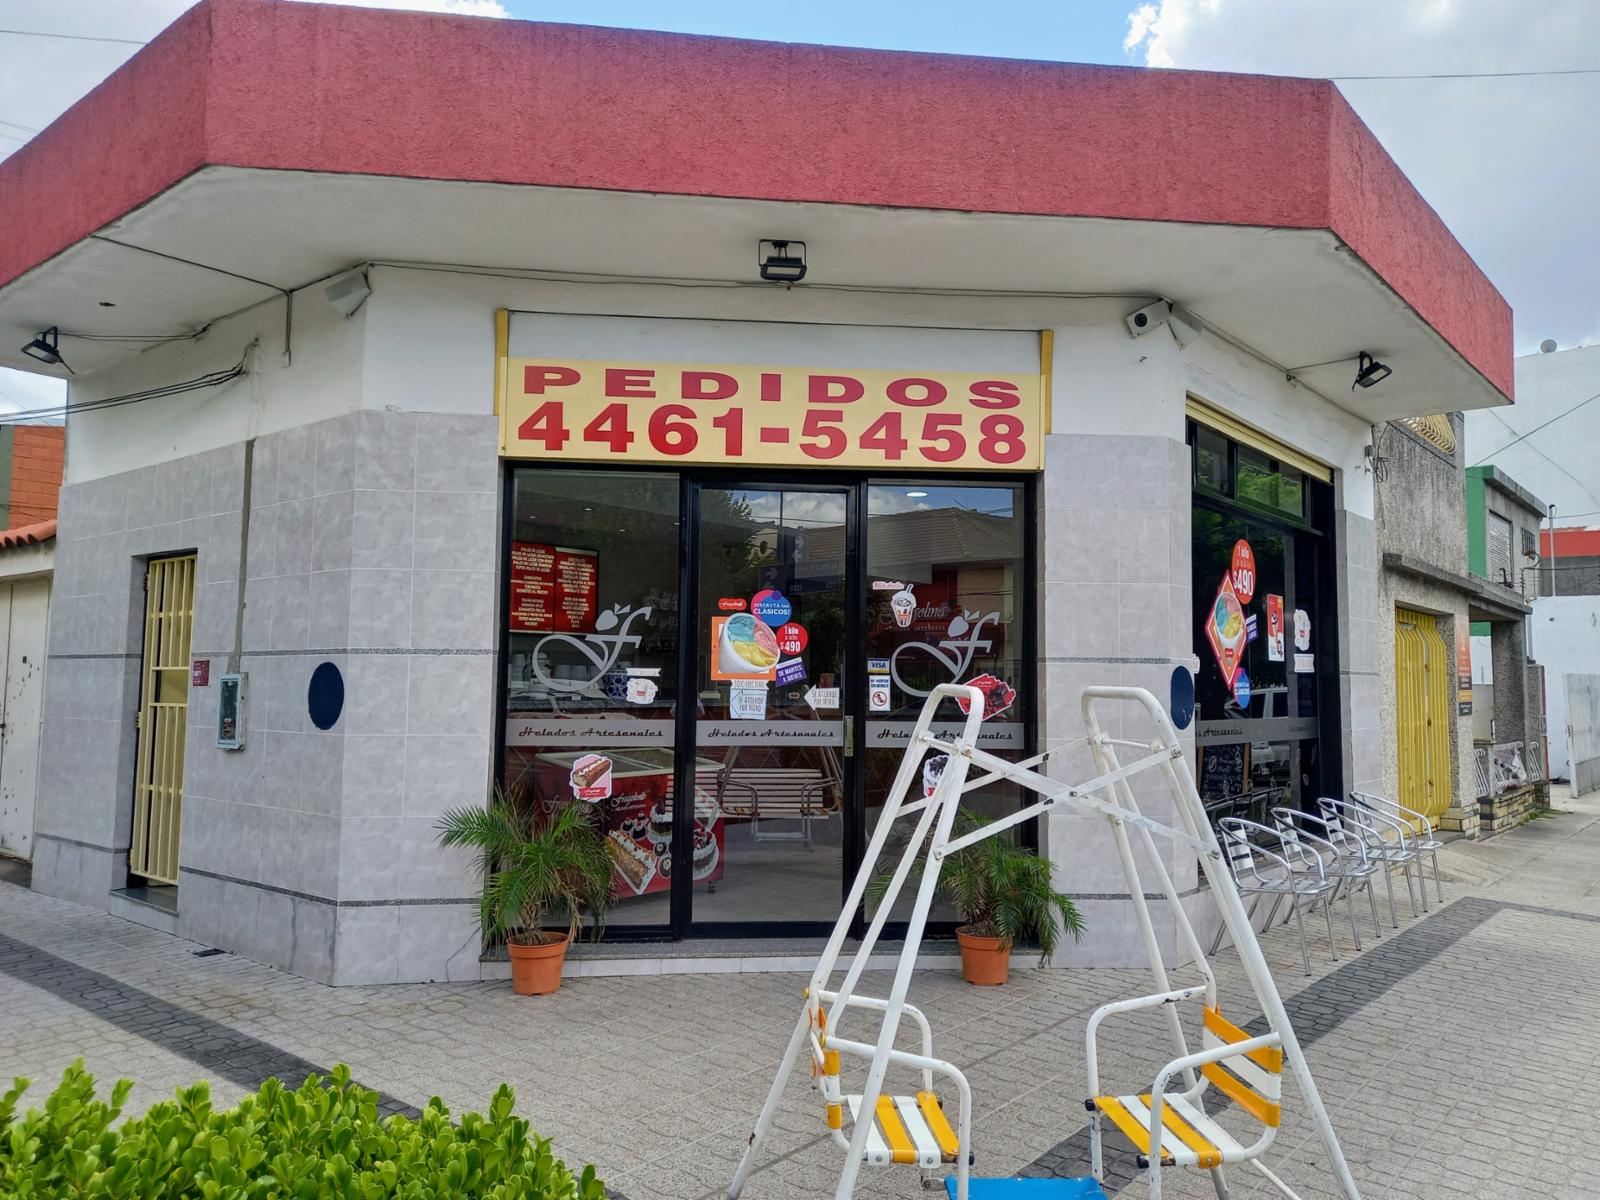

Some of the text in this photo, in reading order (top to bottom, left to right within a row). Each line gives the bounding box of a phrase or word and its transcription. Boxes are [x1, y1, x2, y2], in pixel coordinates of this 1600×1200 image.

[523, 364, 1022, 409] PEDIDOS
[517, 401, 1027, 464] 4461-5458
[871, 661, 887, 669] VISA
[518, 726, 664, 738] Helados Artesanales
[707, 728, 835, 738] Helados Artesanales
[876, 728, 913, 740] Hela
